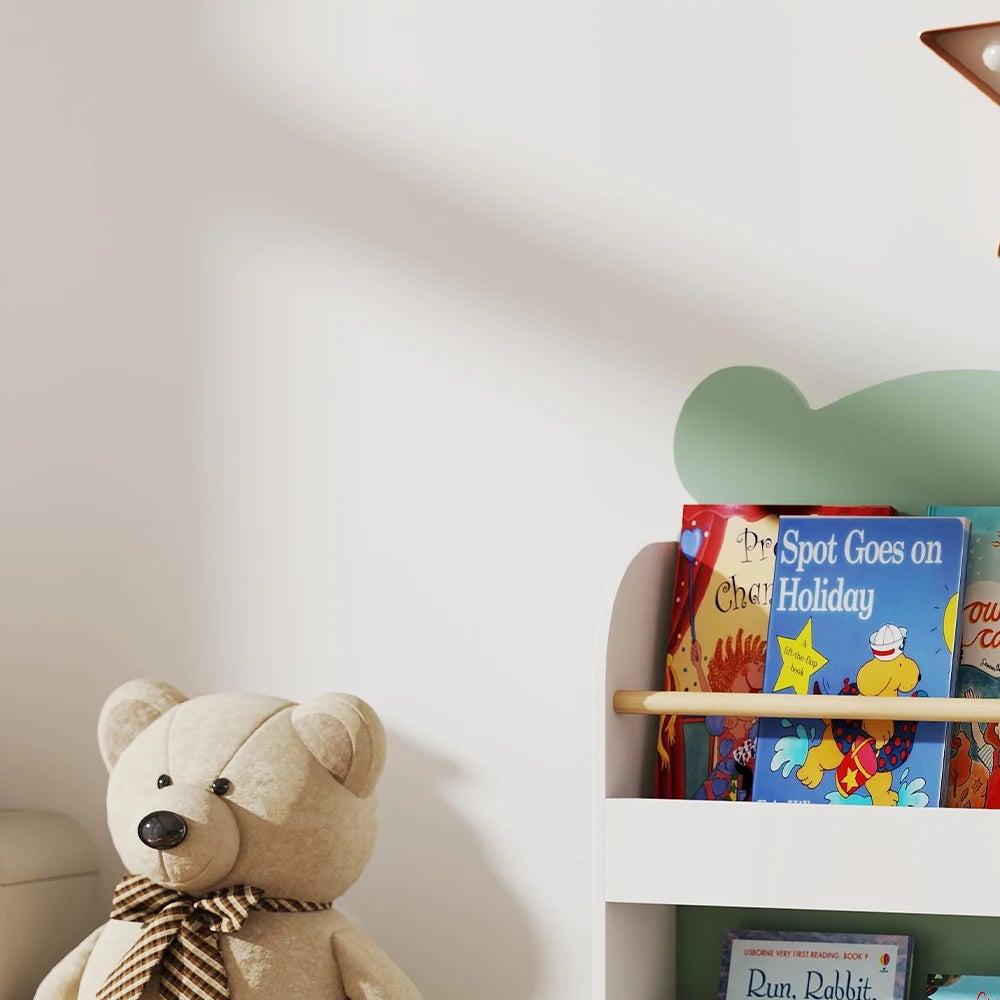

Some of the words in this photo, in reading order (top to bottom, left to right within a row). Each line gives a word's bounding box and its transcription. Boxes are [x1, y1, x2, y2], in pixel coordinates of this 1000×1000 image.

[737, 528, 777, 564] Pr
[780, 529, 838, 573] Spot
[844, 529, 905, 565] Goes
[911, 540, 943, 565] on
[776, 577, 875, 621] Holiday
[791, 663, 804, 677] book
[744, 948, 773, 958] USBORNE
[776, 949, 791, 958] VERY
[793, 950, 809, 958] FIRST
[810, 950, 841, 960] READING:
[843, 952, 863, 961] BOOK
